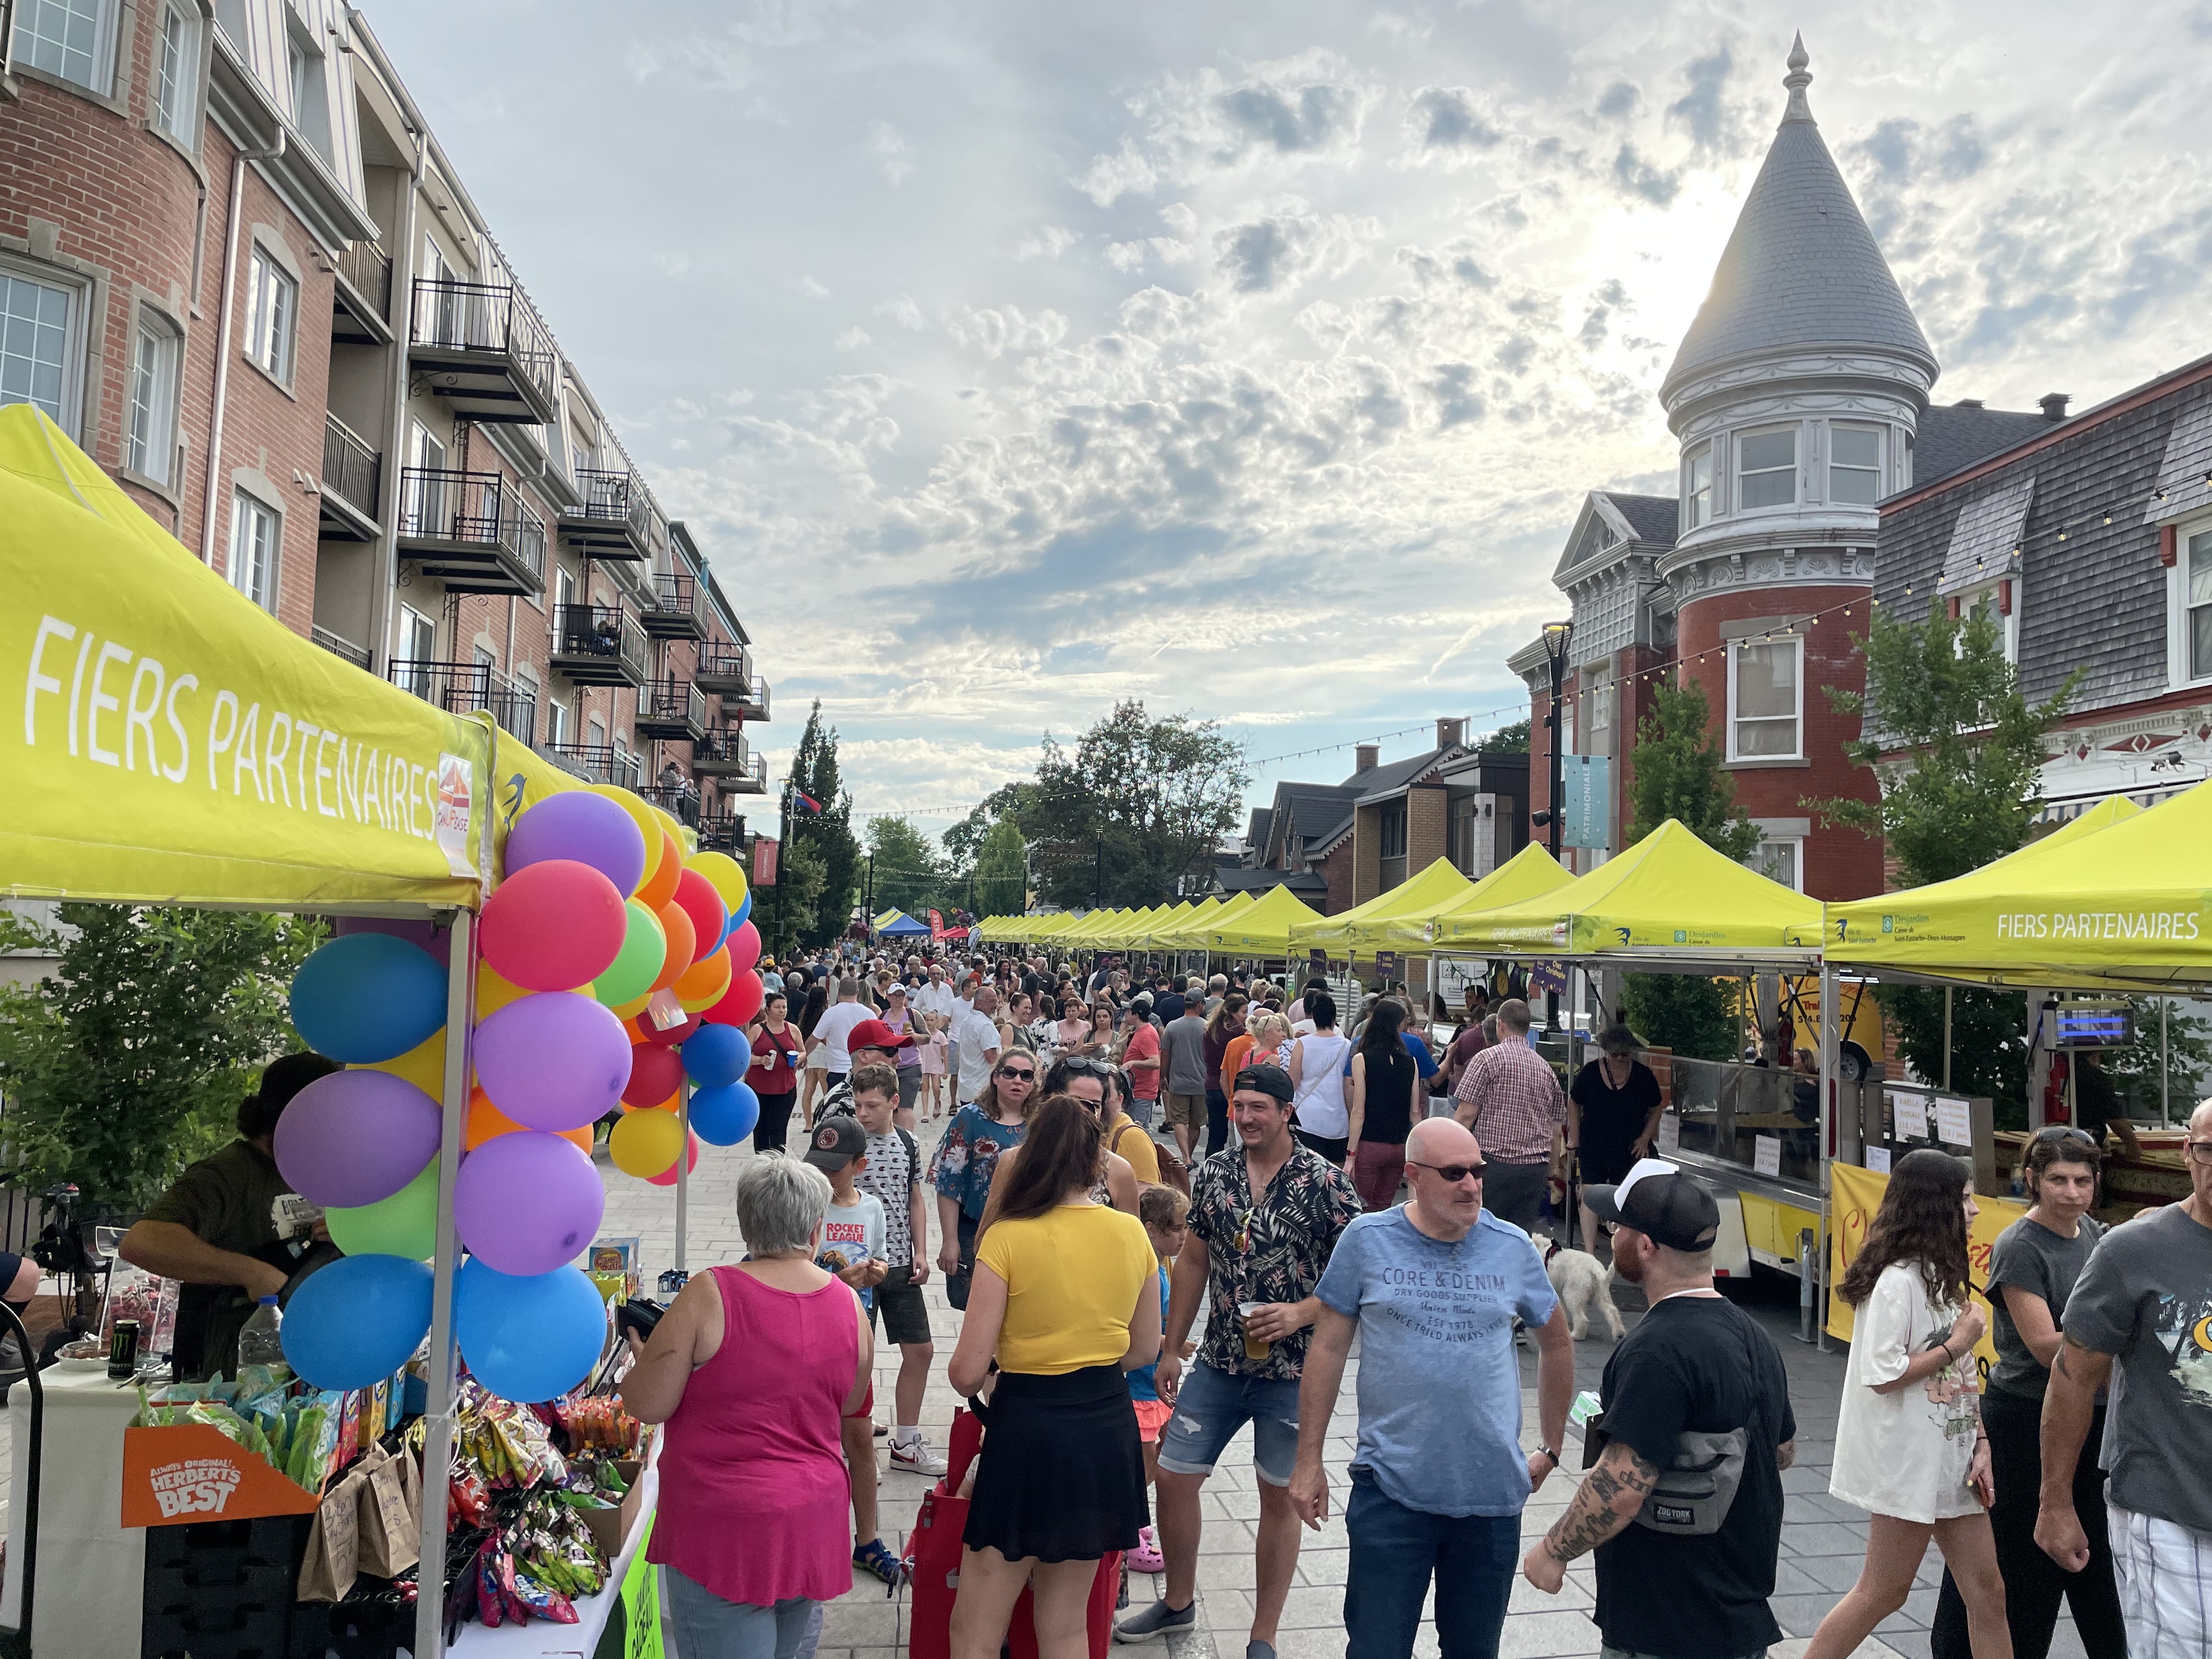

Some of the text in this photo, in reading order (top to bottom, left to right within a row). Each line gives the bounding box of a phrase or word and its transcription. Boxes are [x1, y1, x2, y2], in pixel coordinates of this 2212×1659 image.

[25, 614, 438, 841] FIERS PARTENAIRES
[1582, 765, 1591, 840] PATRIMONIALE
[1895, 915, 1929, 926] Desjardins
[1997, 912, 2198, 939] FIERS PARTENAIRES
[1507, 927, 1553, 941] PARTENAIRES
[1689, 930, 1726, 939] Desjardins
[1553, 960, 1562, 970] Chez
[1545, 966, 1566, 980] Christophe
[827, 1223, 865, 1234] ROCKET
[826, 1232, 864, 1243] LEAGUE
[1383, 1267, 1505, 1292] CORE & DENIM
[1395, 1288, 1413, 1296] DRY
[1417, 1290, 1450, 1300] GOODS
[1387, 1307, 1413, 1328] ONCE
[1414, 1323, 1443, 1340] TRIED
[1446, 1329, 1483, 1342] ALWAYS
[1449, 1321, 1474, 1330] 1978
[150, 1463, 182, 1477] ALWAYS
[151, 1465, 241, 1492] HERBERT'S
[155, 1481, 236, 1519] BEST
[1657, 1506, 1690, 1518] ZOO YORK
